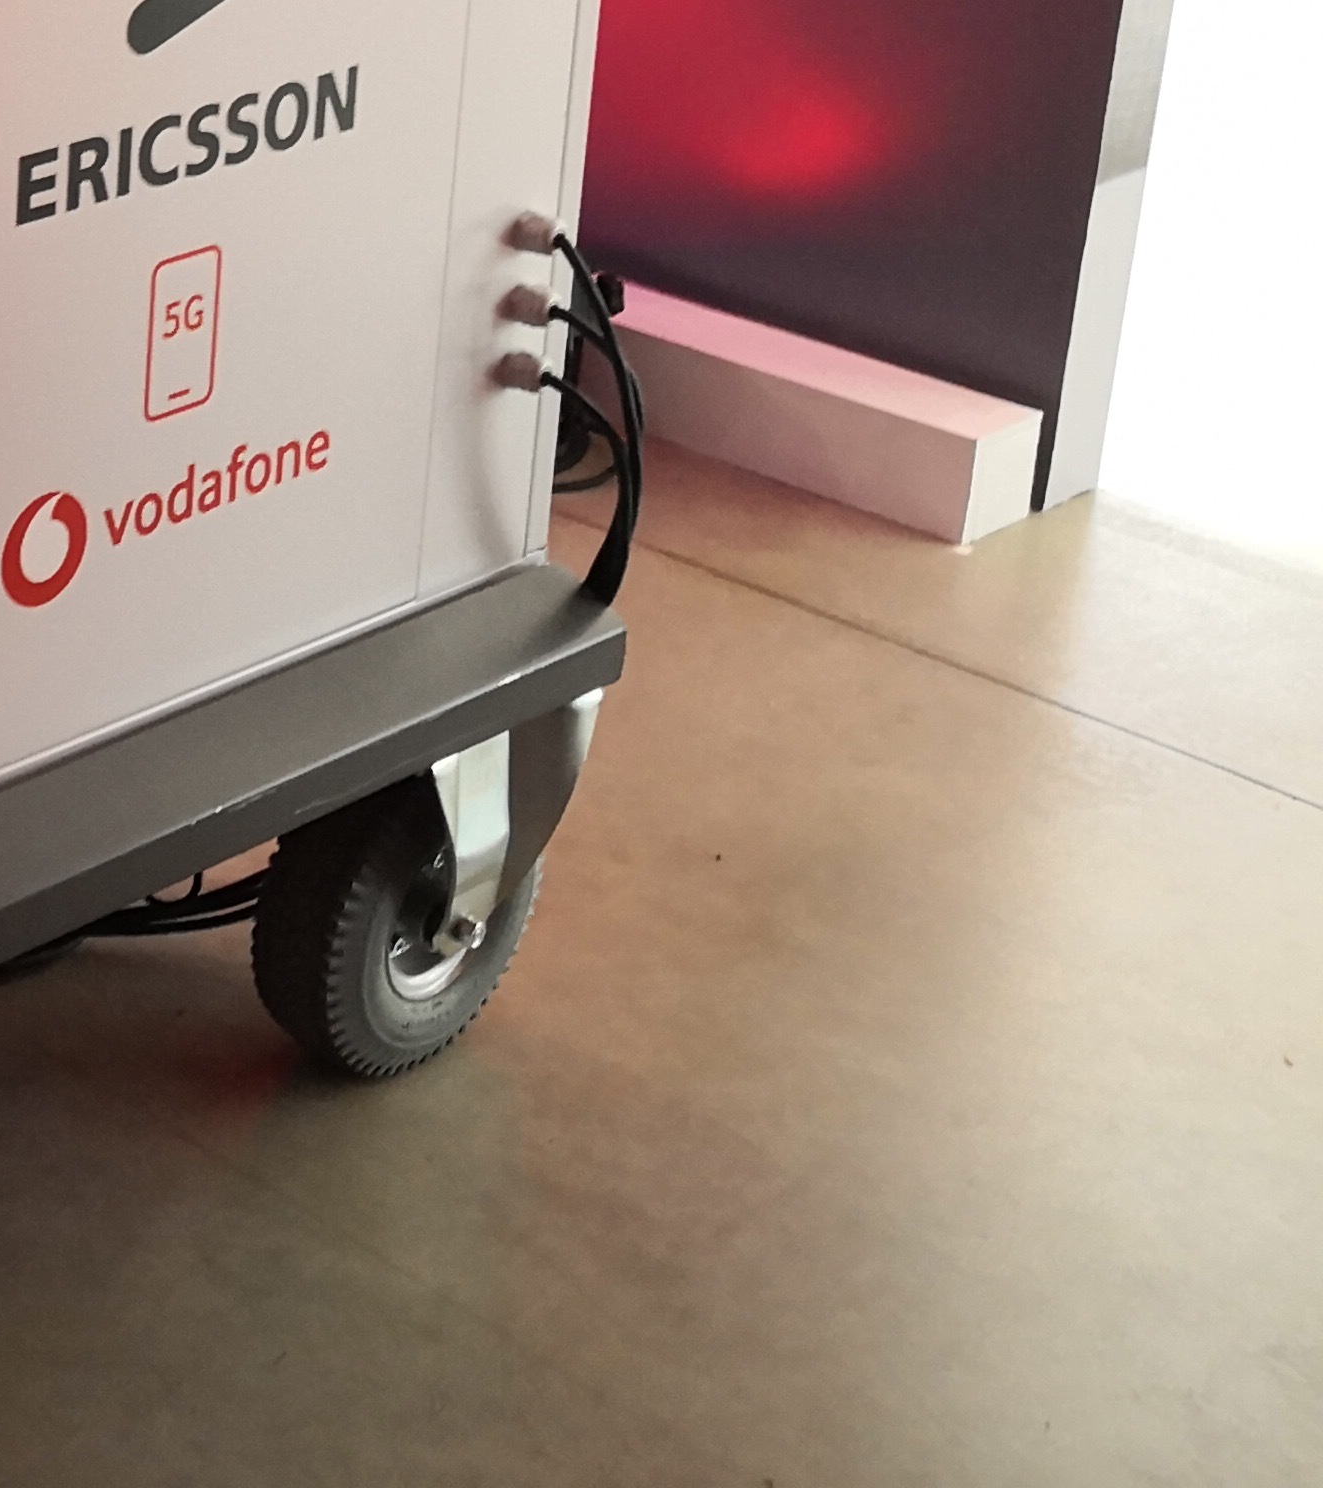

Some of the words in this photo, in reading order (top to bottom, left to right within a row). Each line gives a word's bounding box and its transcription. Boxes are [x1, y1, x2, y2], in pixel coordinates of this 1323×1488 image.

[15, 64, 360, 226] ERICSSON
[161, 293, 206, 340] 5G
[103, 429, 331, 547] vodafone
